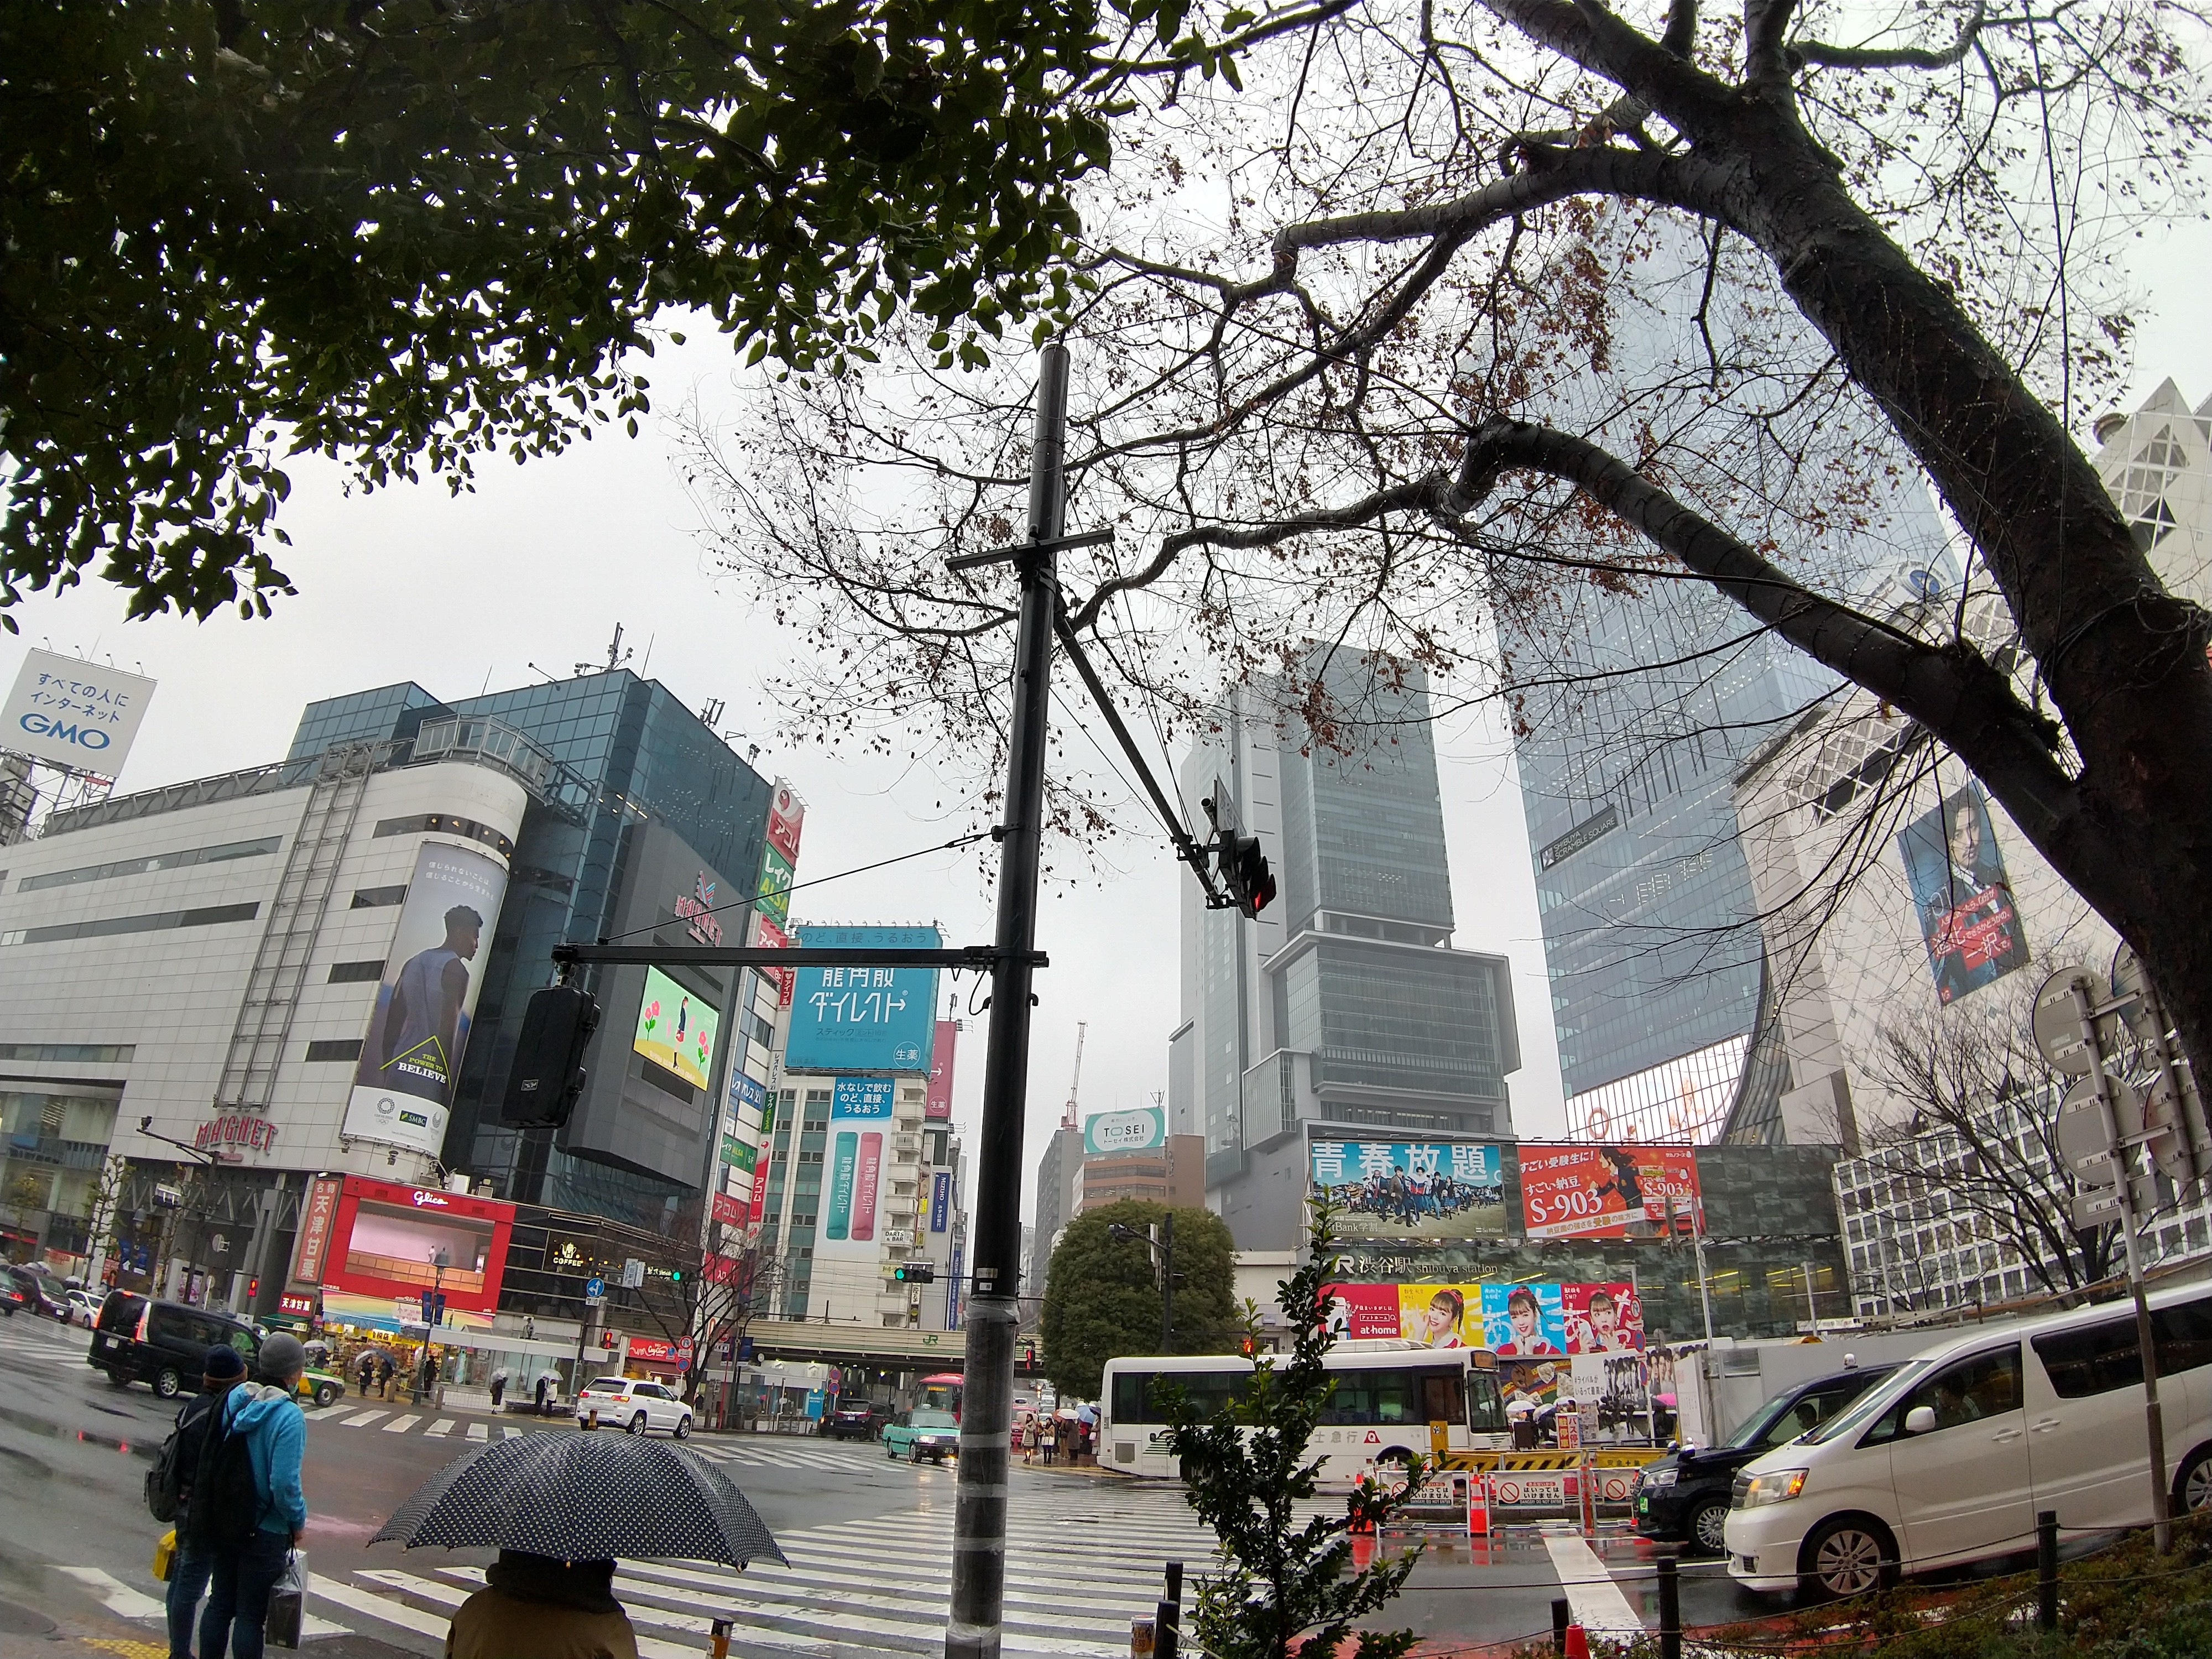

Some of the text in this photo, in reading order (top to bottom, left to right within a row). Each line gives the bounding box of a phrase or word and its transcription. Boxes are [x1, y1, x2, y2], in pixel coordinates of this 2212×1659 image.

[38, 673, 129, 707] すべての人に
[30, 691, 120, 723] インターネット
[19, 713, 111, 750] GMO
[1553, 831, 1581, 852] SHIBUYA
[1554, 816, 1616, 860] SCRAMBLE SQUARE
[674, 894, 723, 946] MAGNET
[801, 931, 927, 945] のど、直接、うるおう
[781, 979, 791, 1005] アイフル
[808, 992, 906, 1023] ダイレクト
[422, 1053, 436, 1062] THE
[895, 1049, 919, 1061] 生薬
[409, 1057, 435, 1069] POWER
[397, 1061, 447, 1084] BELIEVE
[837, 1082, 891, 1093] 水なしで飲む
[840, 1093, 885, 1104] のど、直接、
[930, 1100, 946, 1109] 生薬
[844, 1103, 880, 1114] うるおう
[408, 1114, 426, 1125] SMBC
[195, 1115, 277, 1150] MAGNET
[1104, 1124, 1144, 1137] TOSEI
[1104, 1135, 1144, 1144] トーセイ株式会社
[316, 1182, 335, 1194] 名物
[753, 1177, 764, 1202] アコム
[1525, 1175, 1581, 1197] すごい納豆
[1644, 1182, 1684, 1196] S-903
[414, 1191, 449, 1206] Glico
[1530, 1188, 1603, 1223] S-903
[715, 1199, 737, 1219] アコム
[300, 1196, 331, 1278] 天津甘栗
[552, 1256, 582, 1267] COFFEE
[1334, 1255, 1498, 1274] R 渋谷駅 shibuya station
[281, 1297, 311, 1312] 天津甘栗
[923, 1334, 939, 1344] JR
